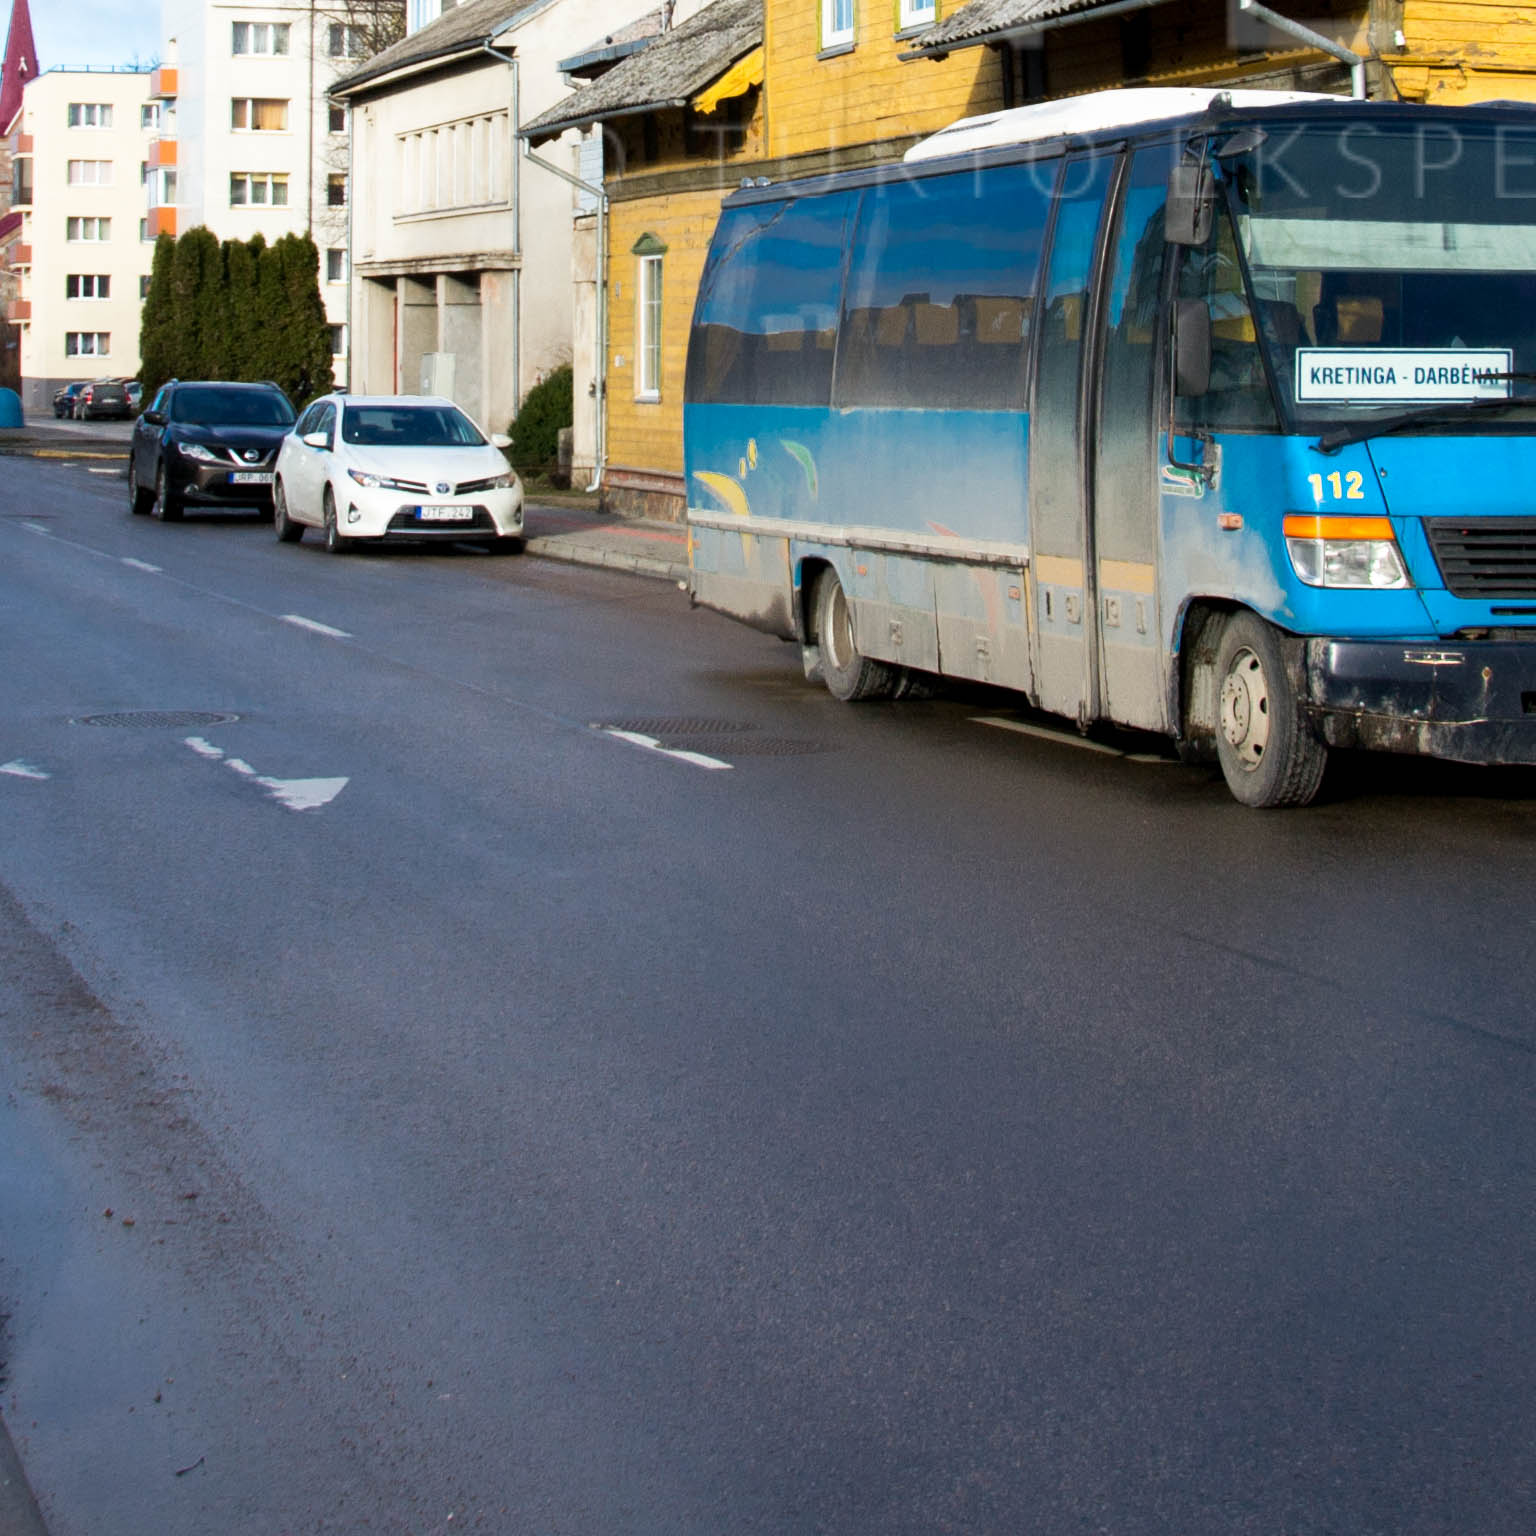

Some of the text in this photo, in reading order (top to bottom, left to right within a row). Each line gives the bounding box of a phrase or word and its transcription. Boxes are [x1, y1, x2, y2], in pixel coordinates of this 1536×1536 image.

[1309, 366, 1398, 386] KRETINGA
[1413, 362, 1501, 386] DARBĖNAI
[1307, 469, 1365, 501] 112
